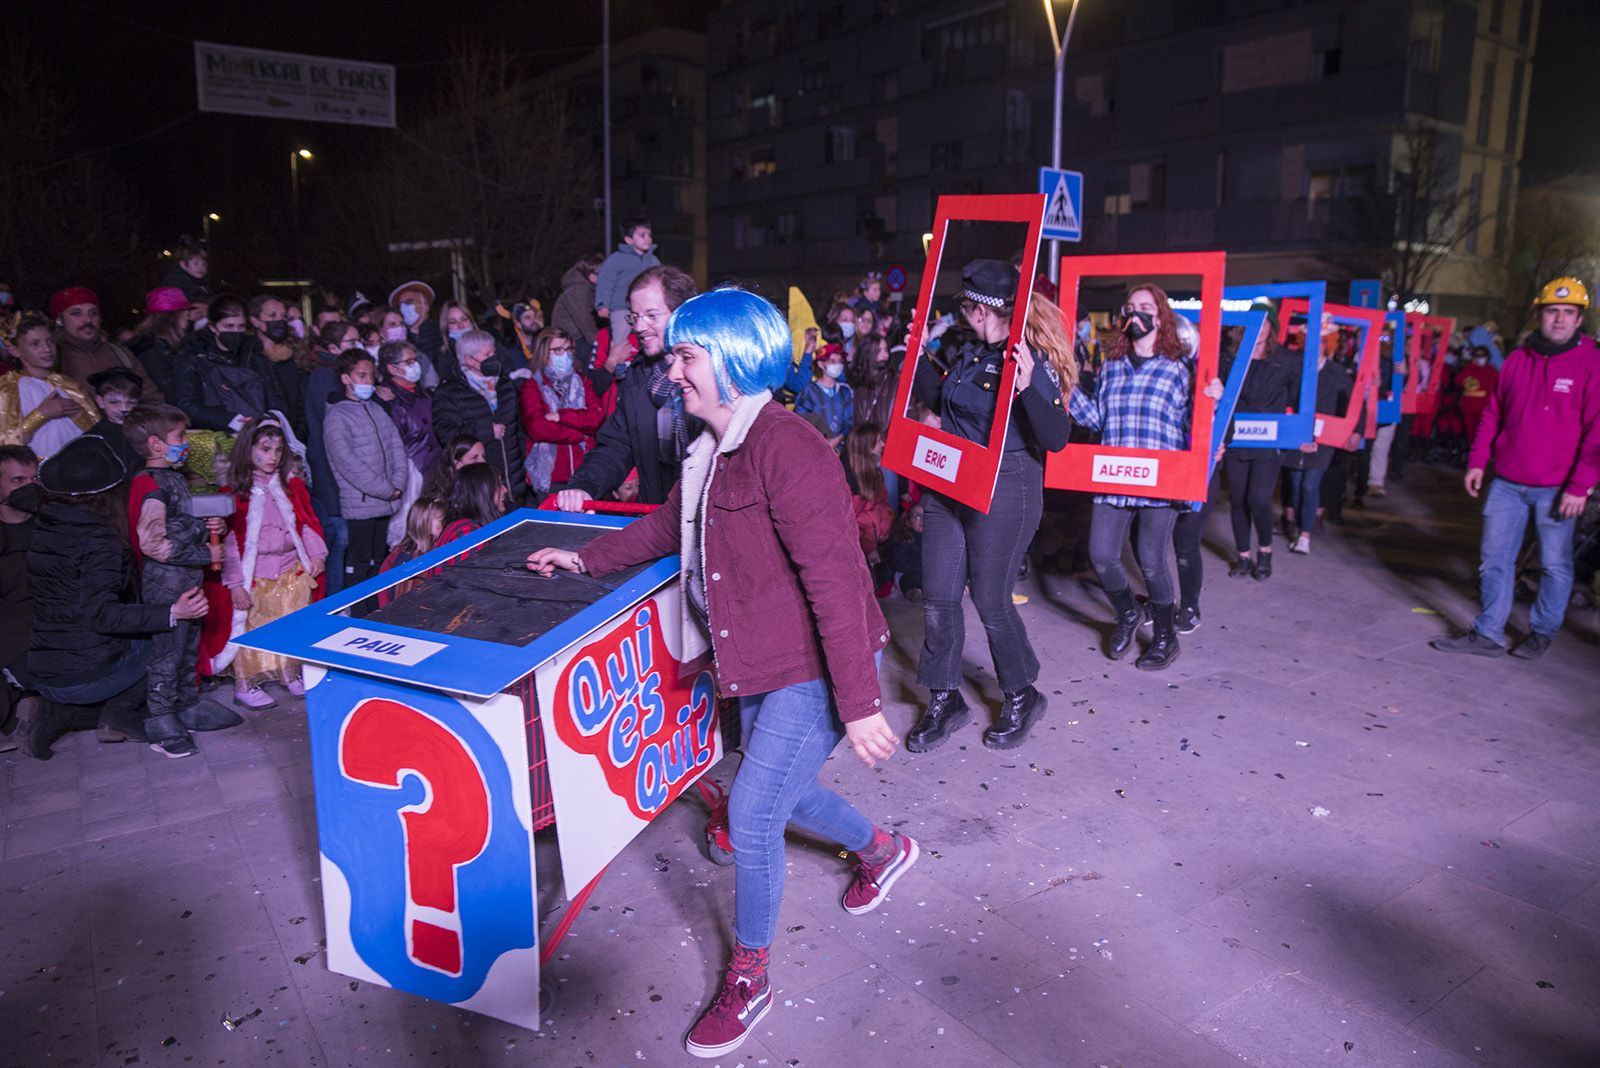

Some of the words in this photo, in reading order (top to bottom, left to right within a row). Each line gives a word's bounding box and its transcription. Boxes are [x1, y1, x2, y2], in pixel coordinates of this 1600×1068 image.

[1238, 426, 1268, 435] MARIA
[925, 449, 947, 469] ERIC
[1099, 464, 1150, 478] ALFRED
[343, 637, 406, 656] PAUL
